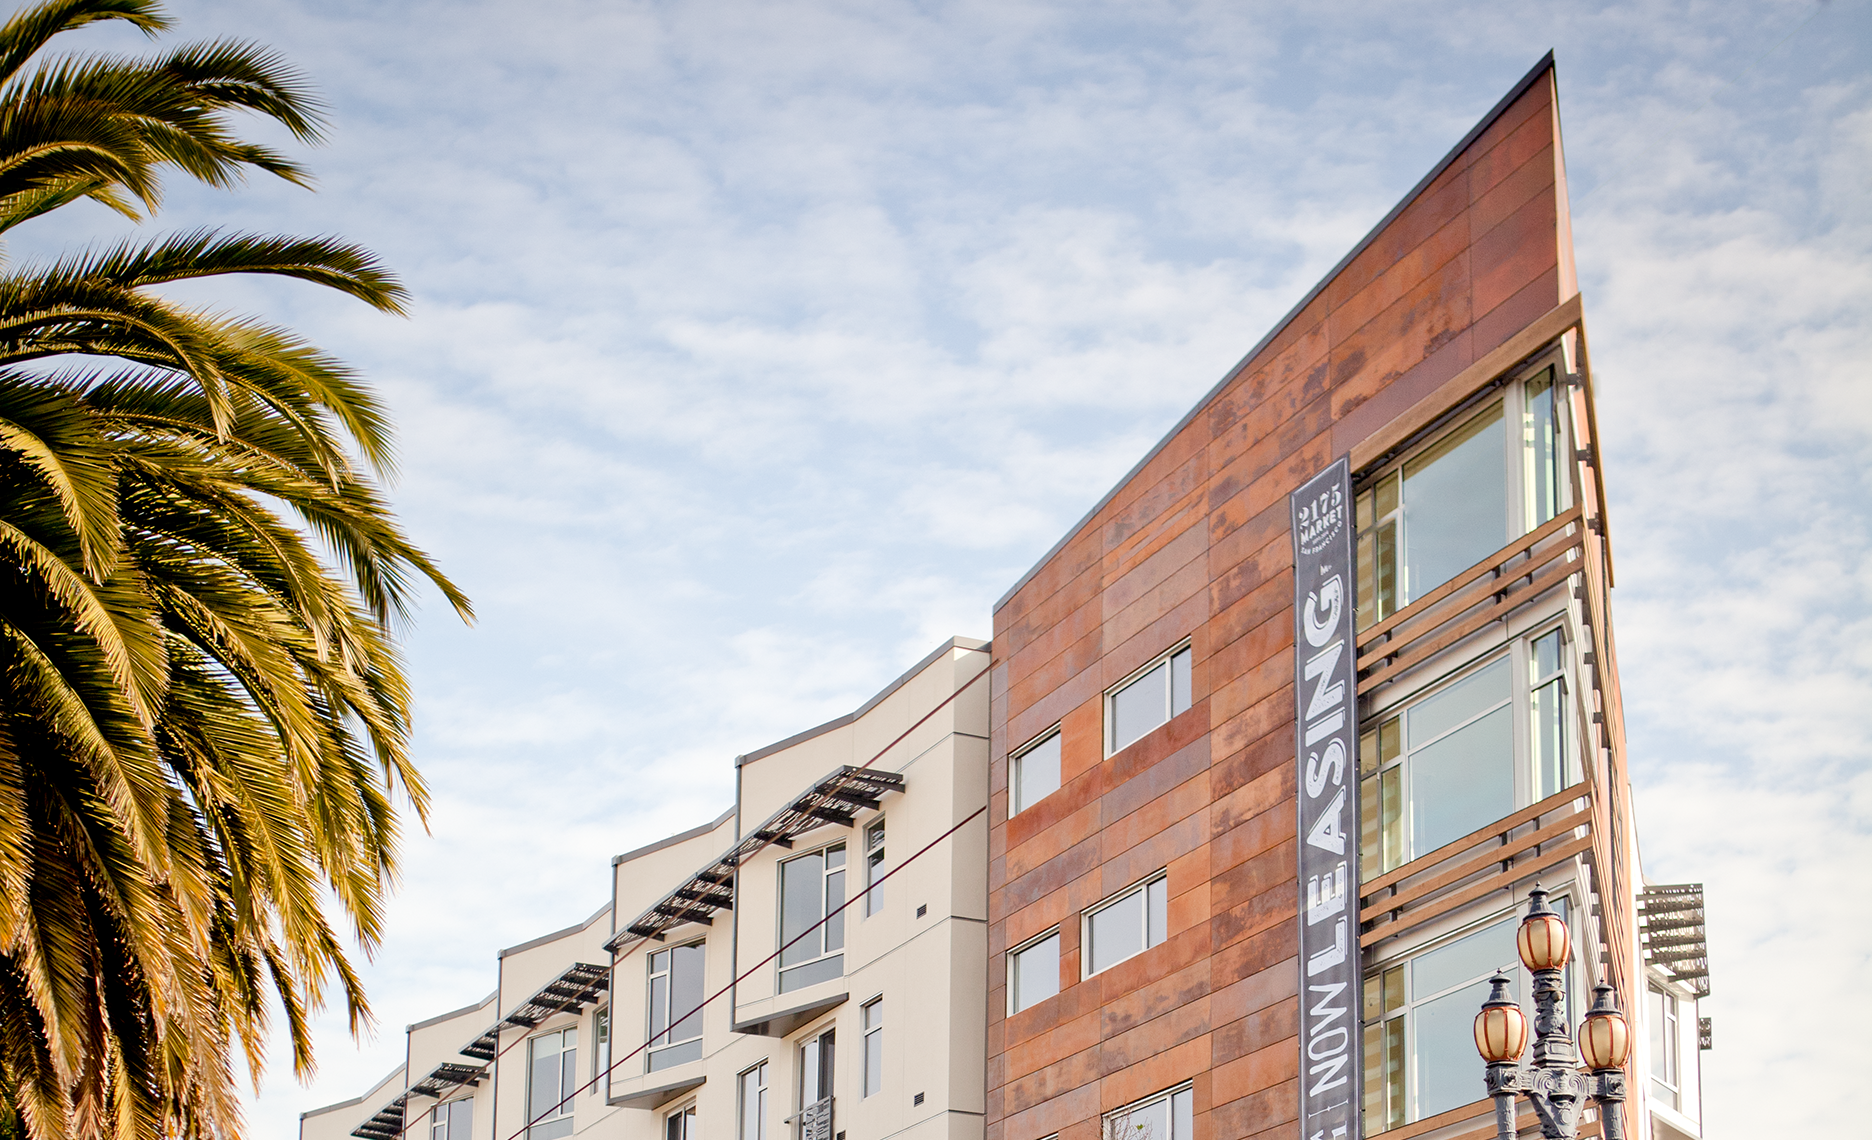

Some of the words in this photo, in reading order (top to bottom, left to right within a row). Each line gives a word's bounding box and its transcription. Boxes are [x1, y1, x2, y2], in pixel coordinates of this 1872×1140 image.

[1298, 482, 1342, 529] 2175
[1300, 505, 1342, 545] MARKET
[1300, 546, 1311, 555] SAN
[1312, 520, 1342, 554] FRANCISCO
[1303, 573, 1347, 977] LEASING
[1307, 981, 1348, 1097] NOW
